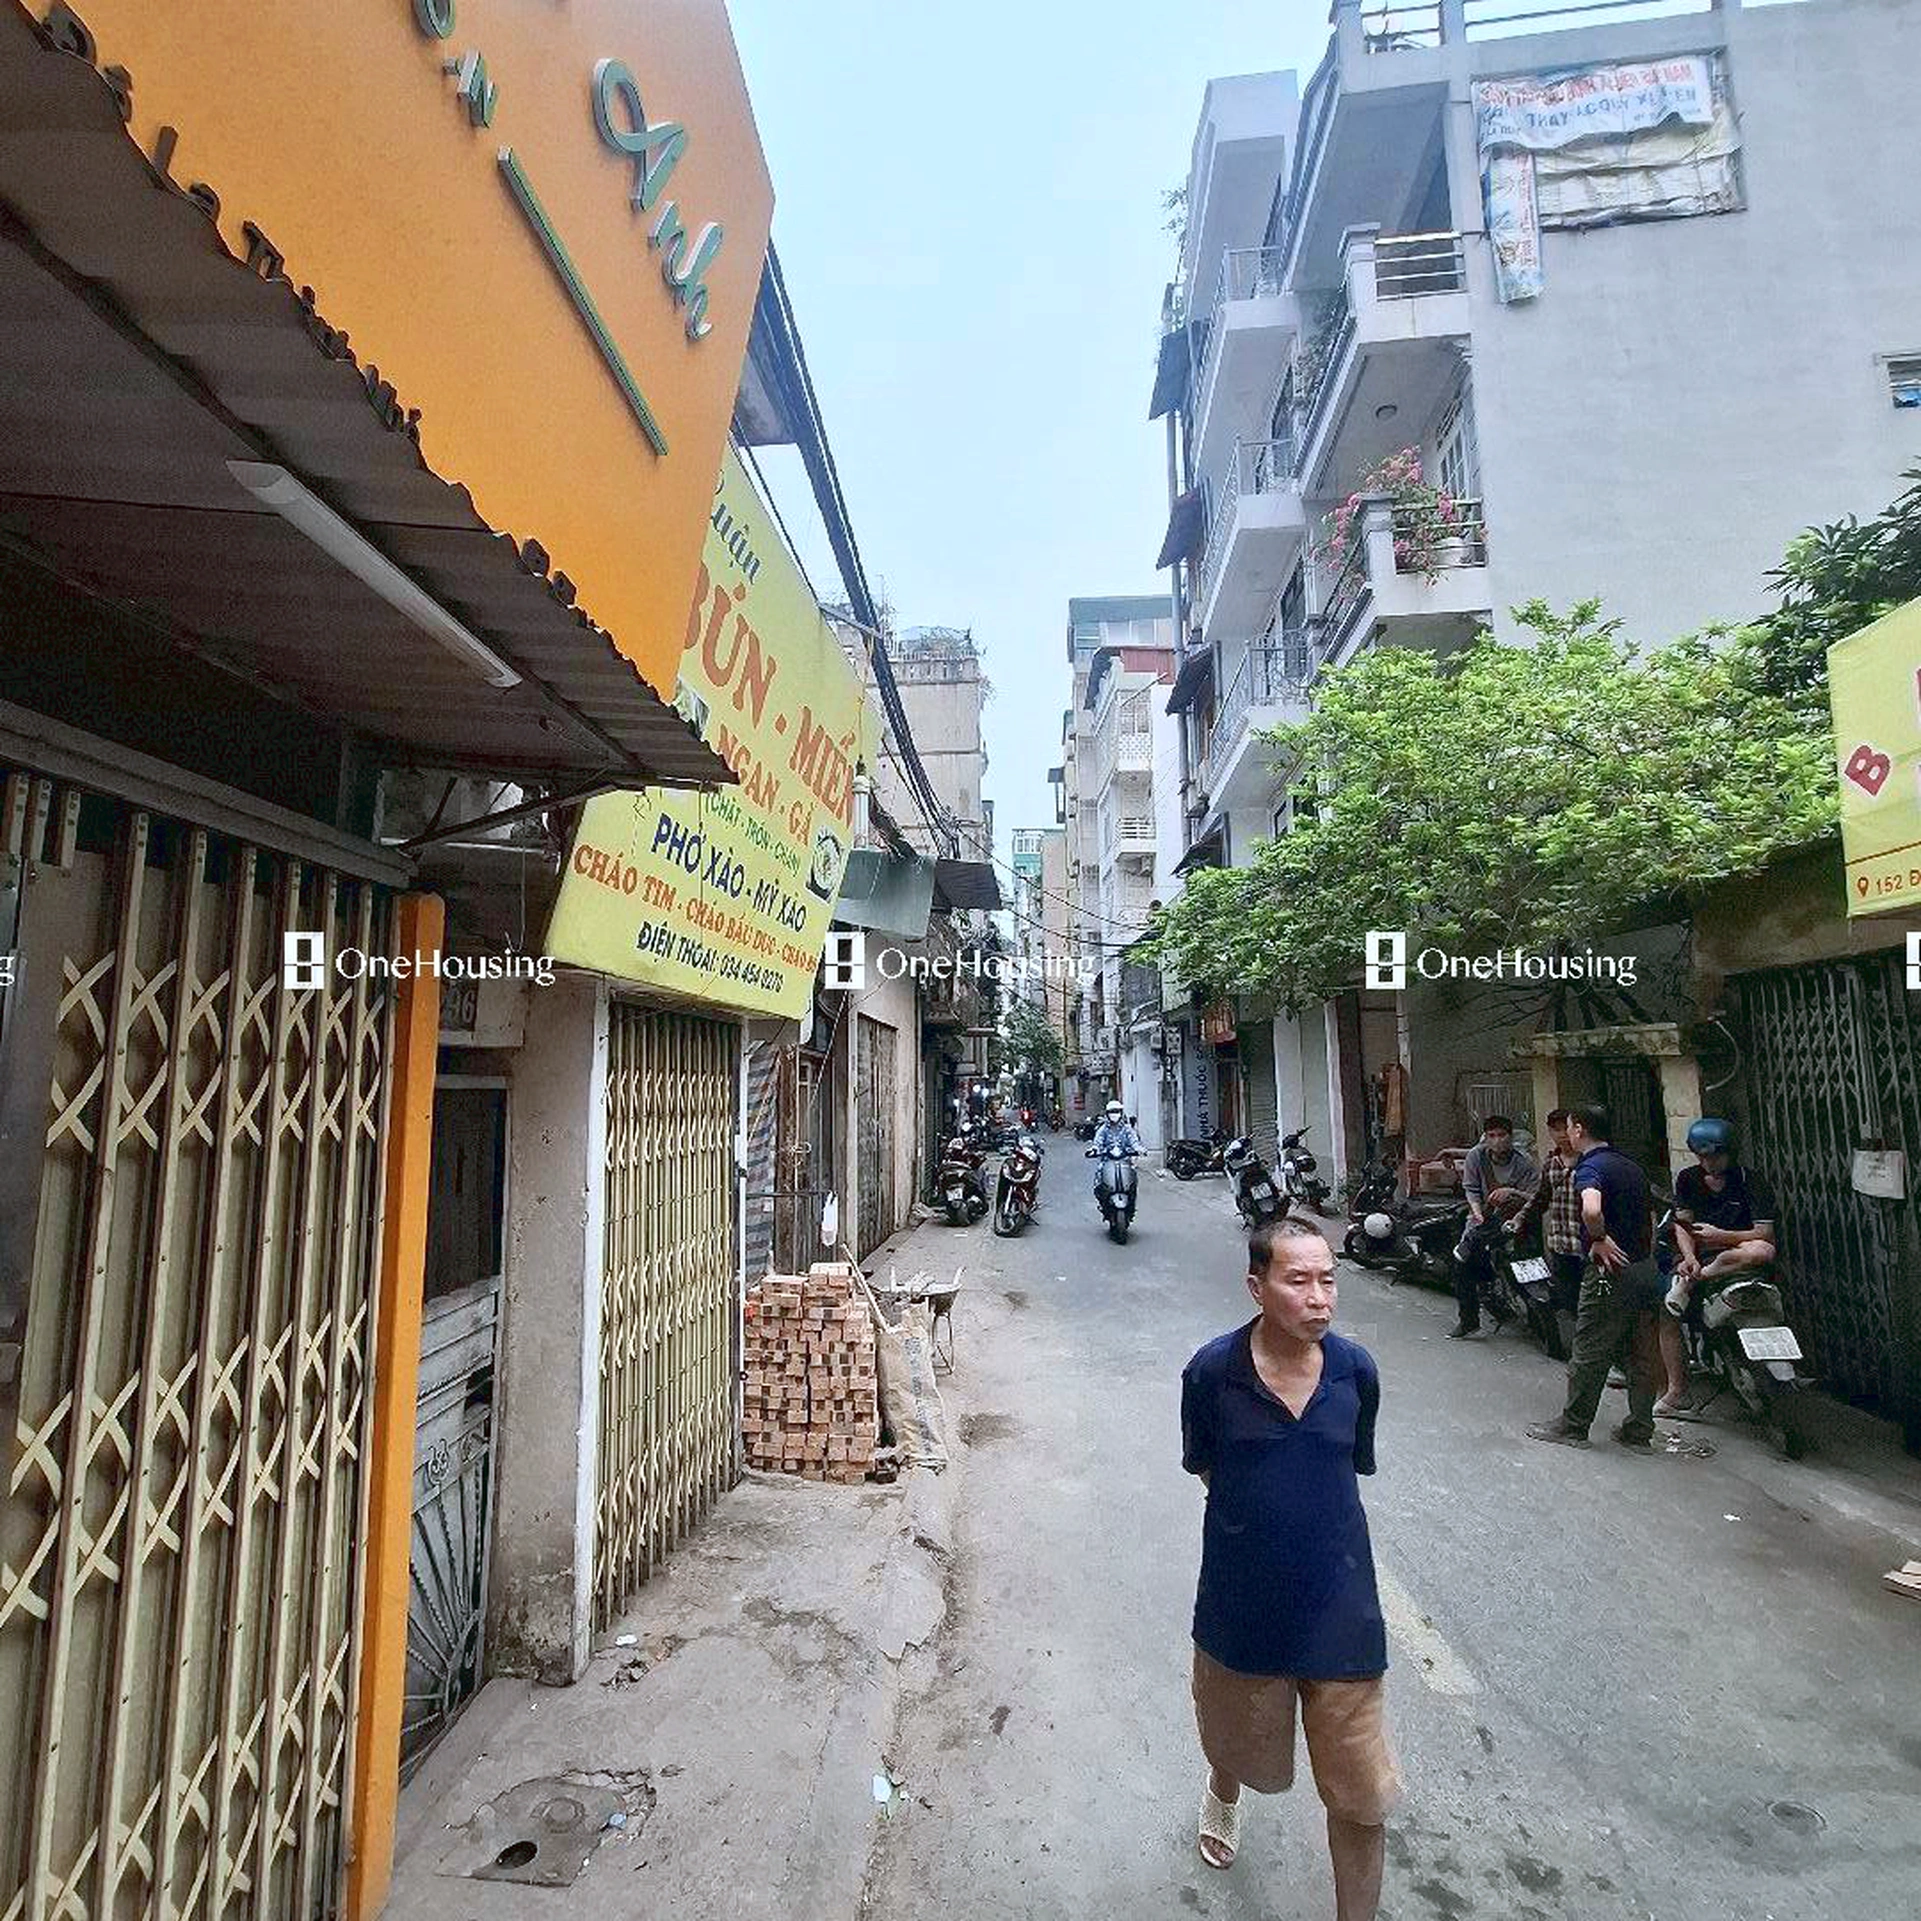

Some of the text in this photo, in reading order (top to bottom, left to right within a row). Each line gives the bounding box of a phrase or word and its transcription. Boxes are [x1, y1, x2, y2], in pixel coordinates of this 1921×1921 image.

[573, 844, 639, 896] CHÁO
[642, 874, 678, 914] TIM
[651, 812, 707, 874] PHỞ
[702, 844, 746, 899] XÀO
[1875, 874, 1903, 897] 152
[636, 920, 677, 963] ĐIỆN
